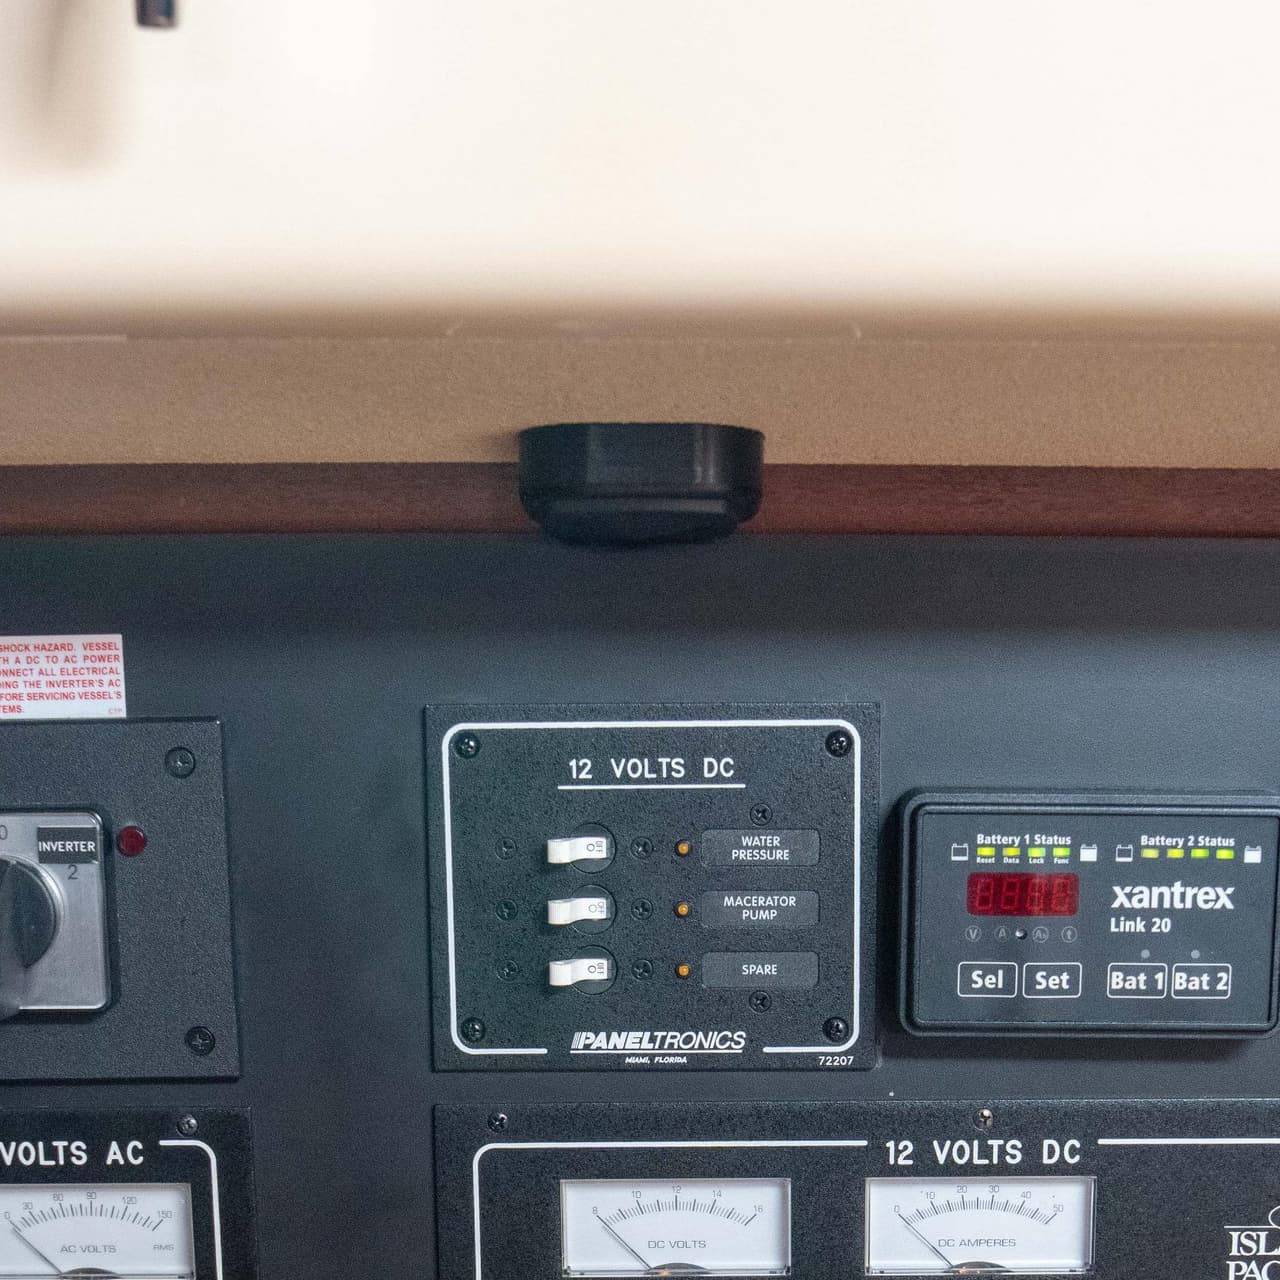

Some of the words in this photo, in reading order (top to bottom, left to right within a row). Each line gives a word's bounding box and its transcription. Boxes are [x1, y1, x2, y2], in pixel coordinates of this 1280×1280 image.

[34, 643, 76, 652] HAZARD.
[83, 642, 119, 651] VESSEL
[39, 668, 55, 676] ALL
[60, 667, 120, 676] ELECTRICAL
[27, 692, 76, 701] SERVICING
[79, 692, 121, 701] VESSEL'S
[570, 760, 592, 779] 12
[611, 758, 685, 778] VOLTS
[704, 758, 734, 777] DC
[741, 836, 780, 847] WATER
[977, 834, 1021, 846] Battery
[1024, 834, 1030, 845] 1
[1034, 834, 1071, 845] Status
[1141, 835, 1184, 848] Battery
[1188, 836, 1194, 846] 2
[1198, 836, 1235, 847] Status
[39, 841, 95, 853] INVERTER
[732, 849, 789, 860] PRESSURE
[1112, 881, 1234, 910] xantrex
[724, 896, 796, 908] MACERATOR
[742, 908, 777, 919] PUMP
[1110, 918, 1145, 933] Link
[1151, 918, 1171, 933] 20
[742, 964, 777, 976] SPARE
[971, 970, 1003, 989] Sel
[1035, 971, 1070, 990] Set
[1111, 972, 1147, 991] Bat
[1154, 972, 1164, 990] 1
[1175, 972, 1211, 991] Bat
[1217, 973, 1228, 991] 2
[571, 1031, 745, 1050] PANELTRONICS
[818, 1055, 854, 1065] 72207
[0, 1142, 87, 1165] VOLTS
[106, 1142, 144, 1164] AC
[886, 1141, 913, 1165] 12
[933, 1140, 1022, 1165] VOLTS
[1043, 1140, 1081, 1164] DC
[648, 1240, 665, 1248] DC
[670, 1240, 706, 1248] VOLTS
[939, 1239, 955, 1247] DC
[959, 1238, 1016, 1247] AMPERES
